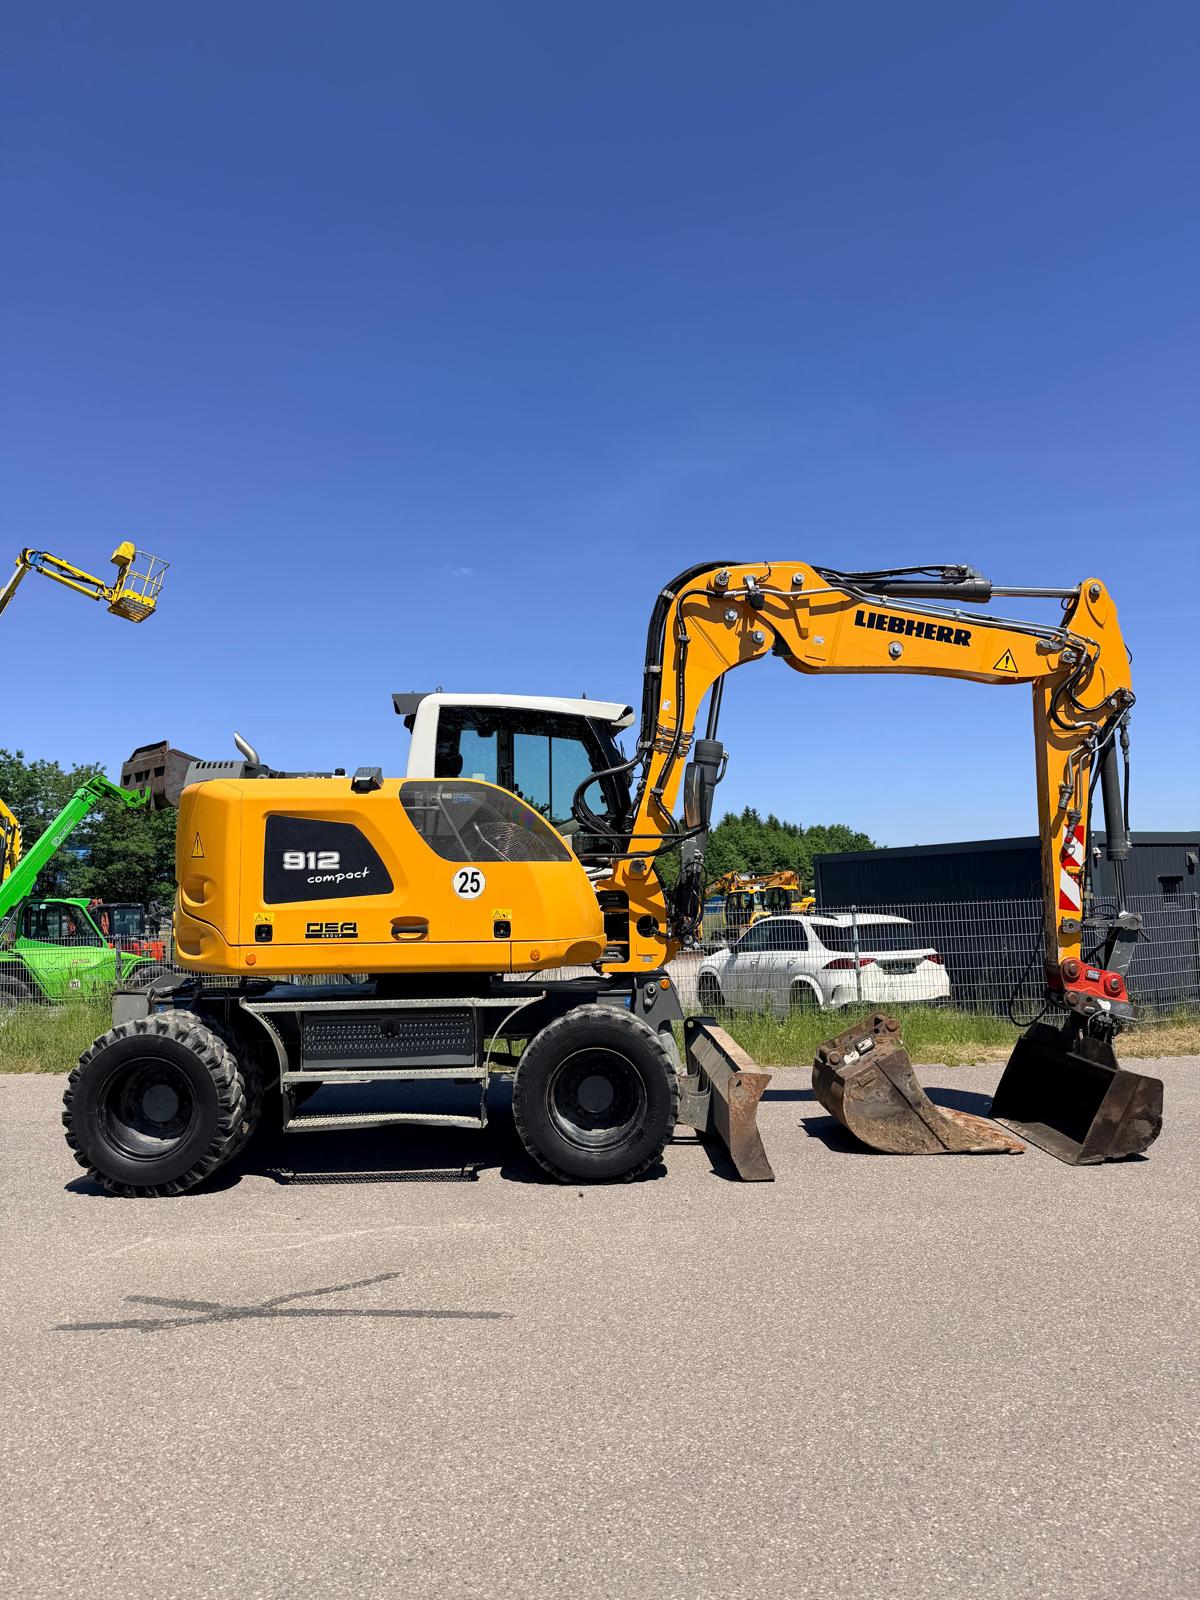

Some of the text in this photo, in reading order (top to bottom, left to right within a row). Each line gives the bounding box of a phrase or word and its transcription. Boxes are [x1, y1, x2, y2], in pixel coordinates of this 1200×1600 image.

[854, 610, 972, 647] LIEBHERR
[283, 851, 340, 870] 912
[307, 867, 369, 884] compact
[459, 871, 480, 893] 25
